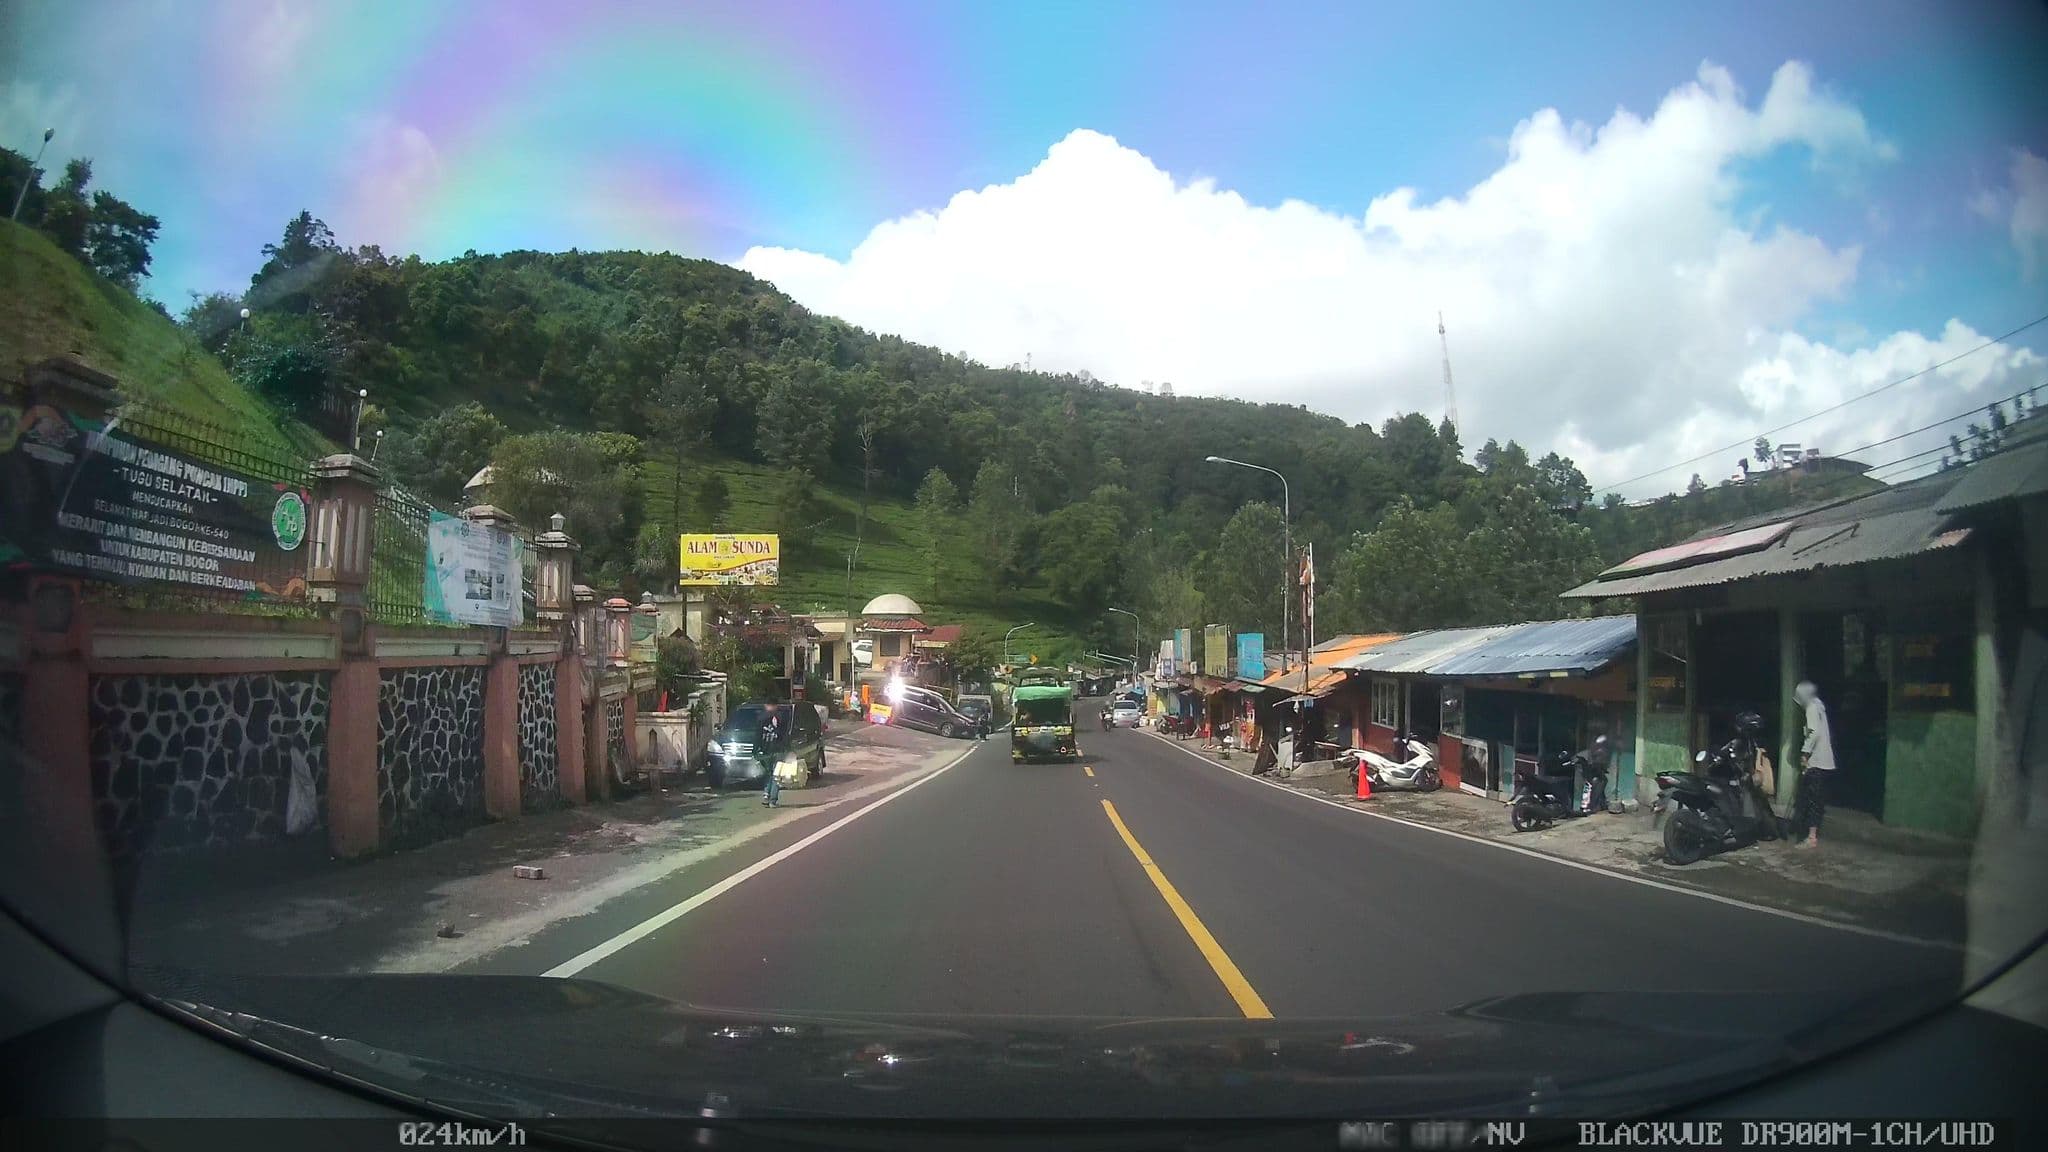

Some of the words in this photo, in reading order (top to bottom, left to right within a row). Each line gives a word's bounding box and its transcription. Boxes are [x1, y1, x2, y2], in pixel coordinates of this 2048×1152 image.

[106, 521, 128, 538] DAN
[188, 538, 256, 563] KEBERSAMAAN
[687, 541, 717, 554] ALAM
[732, 541, 770, 554] SUNDA
[52, 549, 84, 567] YANG
[128, 562, 167, 580] NYAMAN
[168, 568, 189, 583] DAN
[130, 544, 183, 566] KABUPATEN
[184, 554, 219, 572] BOGOR
